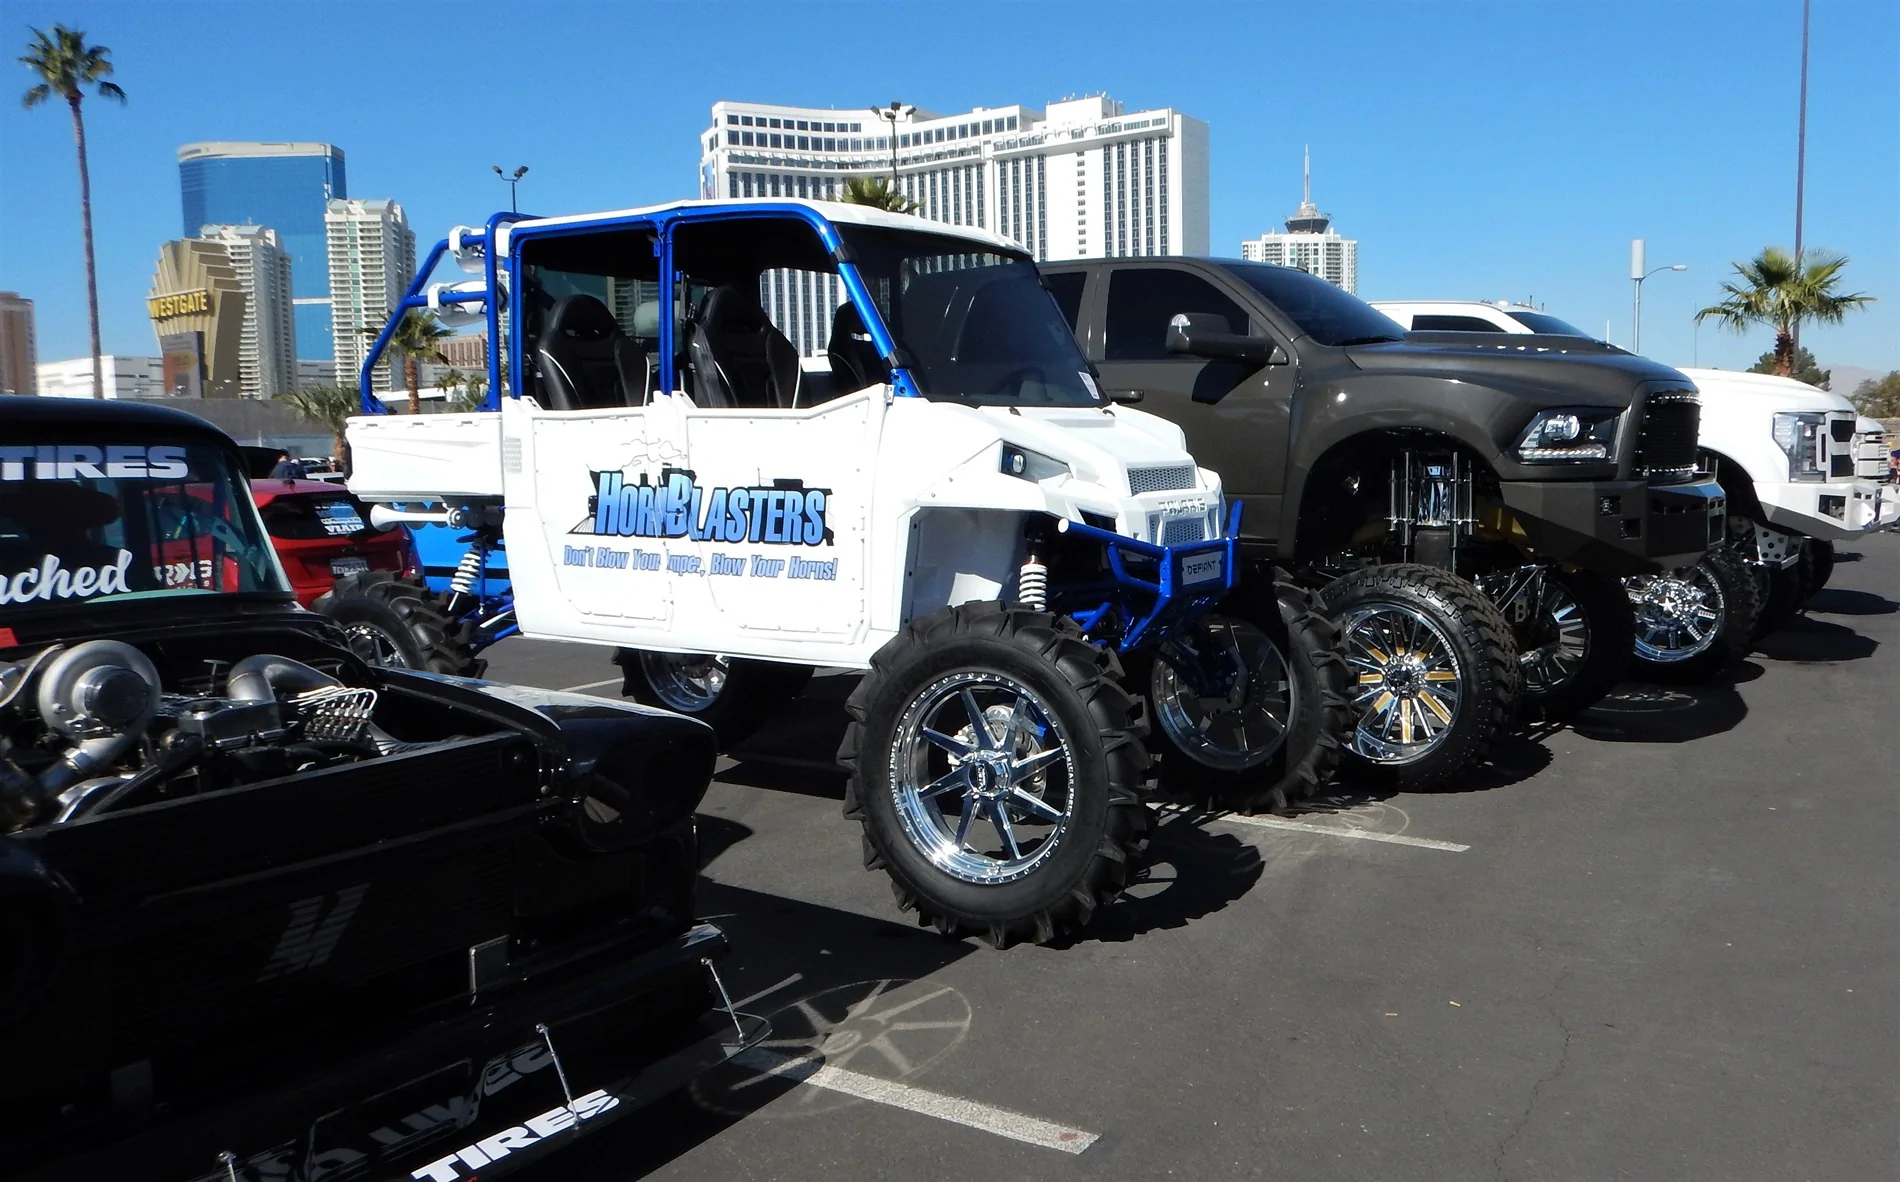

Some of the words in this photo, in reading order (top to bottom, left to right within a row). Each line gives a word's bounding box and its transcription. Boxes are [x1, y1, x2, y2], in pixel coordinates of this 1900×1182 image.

[151, 291, 208, 319] WESTGATE
[0, 445, 189, 481] TIRES
[564, 545, 594, 567] Don't
[596, 547, 630, 569] Blow
[633, 548, 661, 571] Your
[710, 552, 747, 576] Blow
[750, 554, 785, 578] Your
[788, 555, 839, 581] Horns!
[1187, 560, 1217, 576] DEFIANT
[410, 1088, 620, 1182] TIRES
